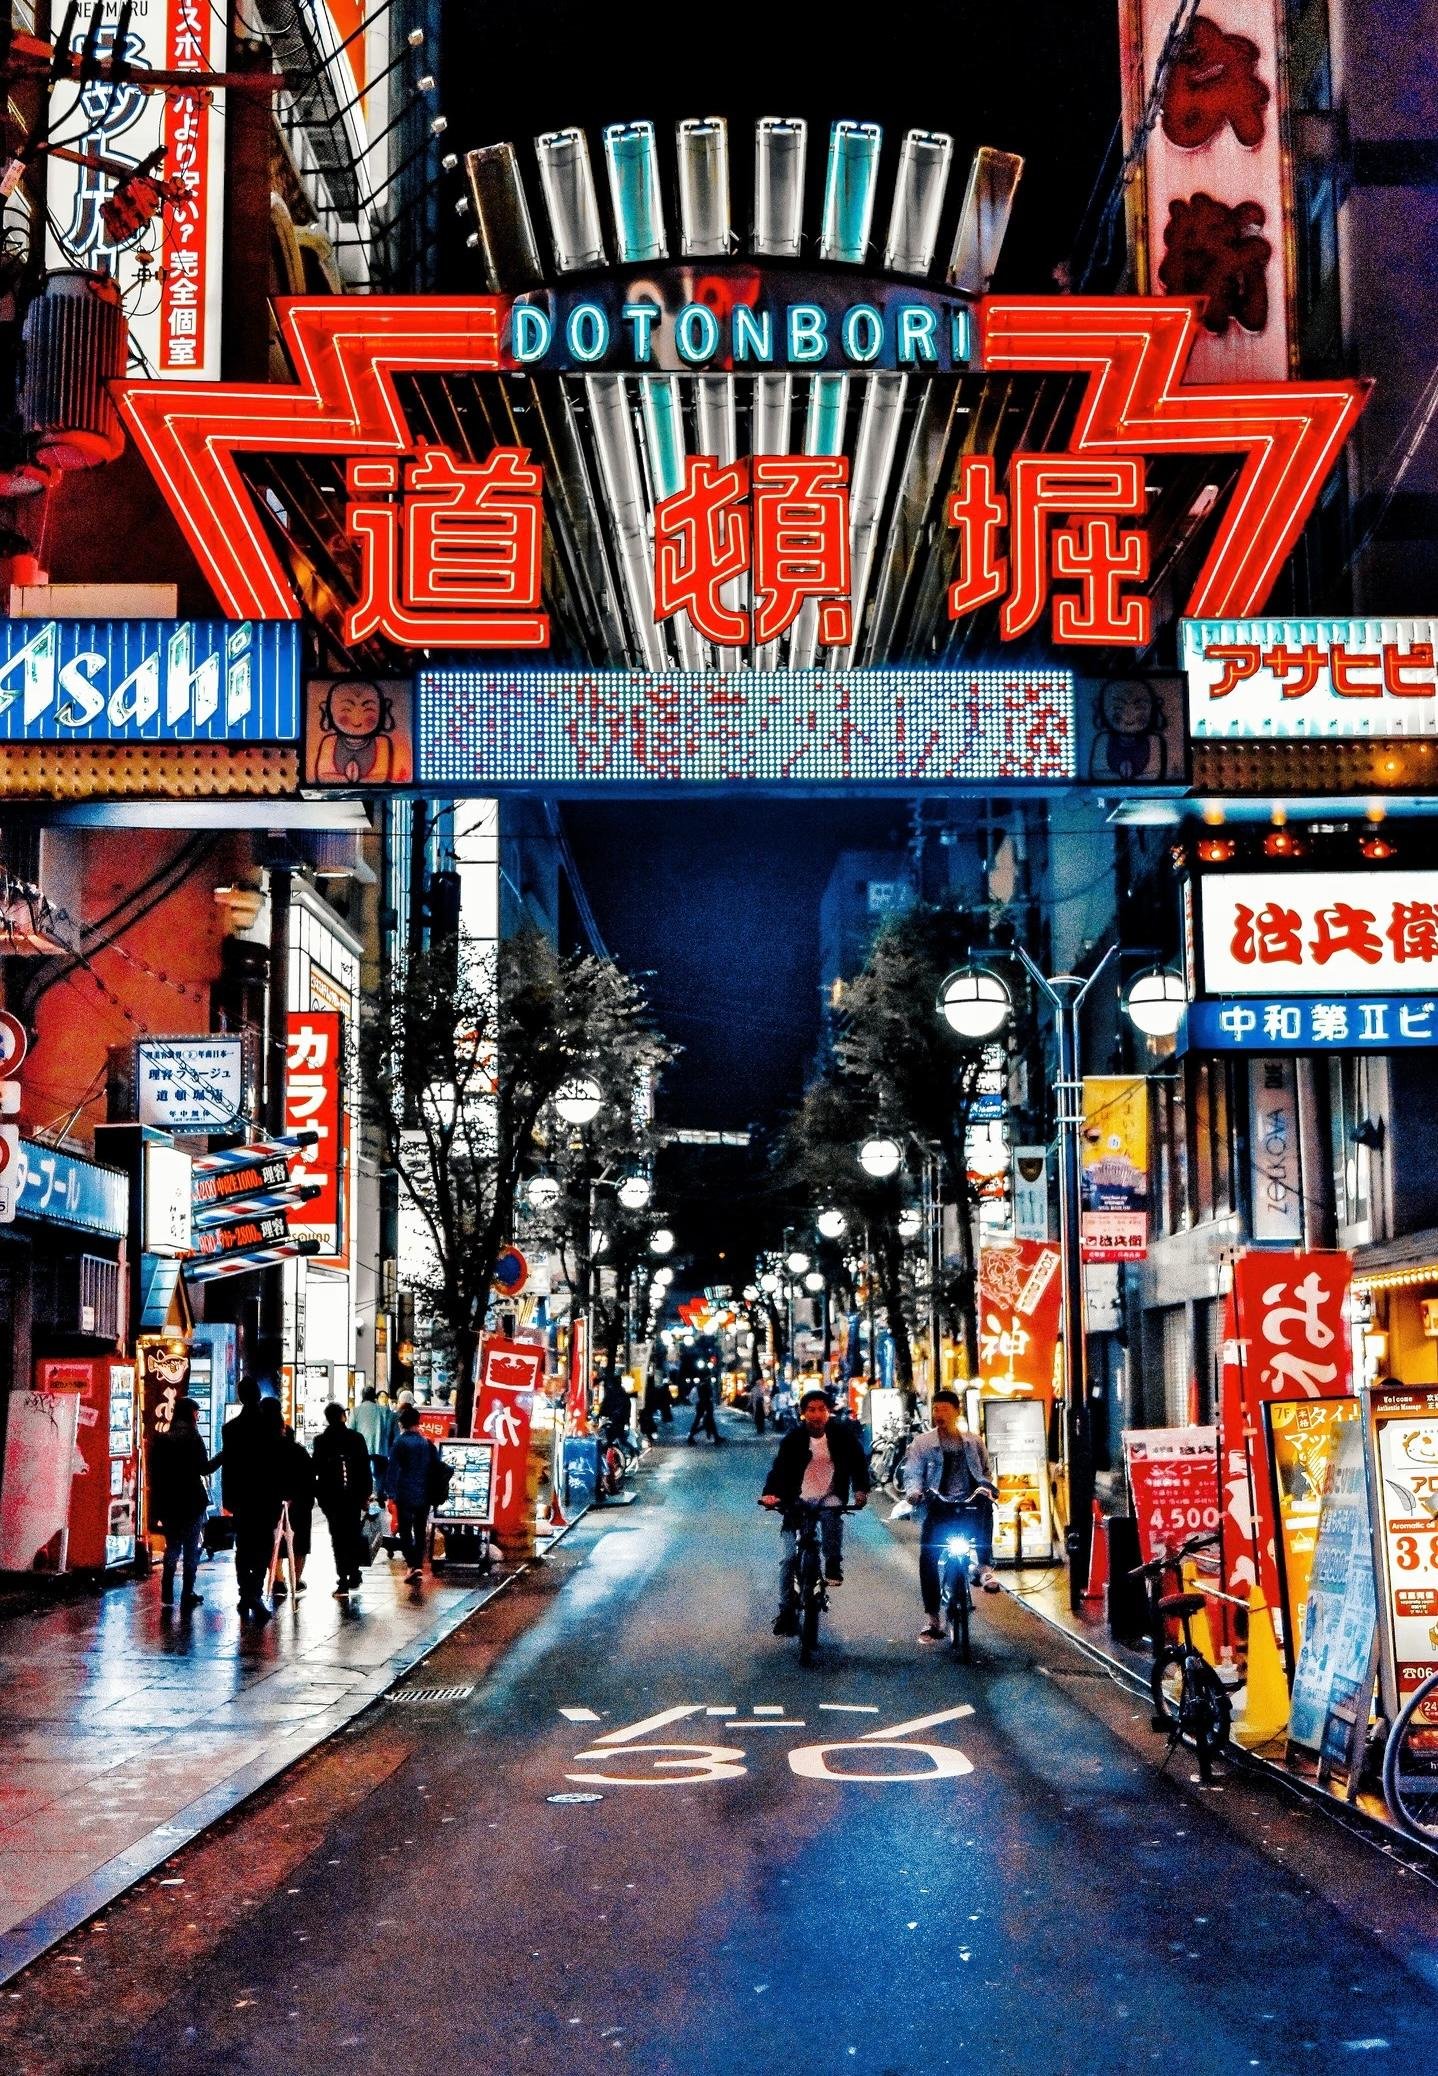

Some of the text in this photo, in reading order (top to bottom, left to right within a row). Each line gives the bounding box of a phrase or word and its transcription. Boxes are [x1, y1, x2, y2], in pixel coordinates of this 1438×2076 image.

[511, 303, 972, 364] DOTONBORI
[344, 443, 1150, 650] 道頓堀
[0, 620, 253, 727] Asahi
[261, 1163, 287, 1184] 理容
[260, 1218, 285, 1239] 理容
[1392, 1522, 1425, 1530] Aromatic
[563, 1742, 976, 1785] 30
